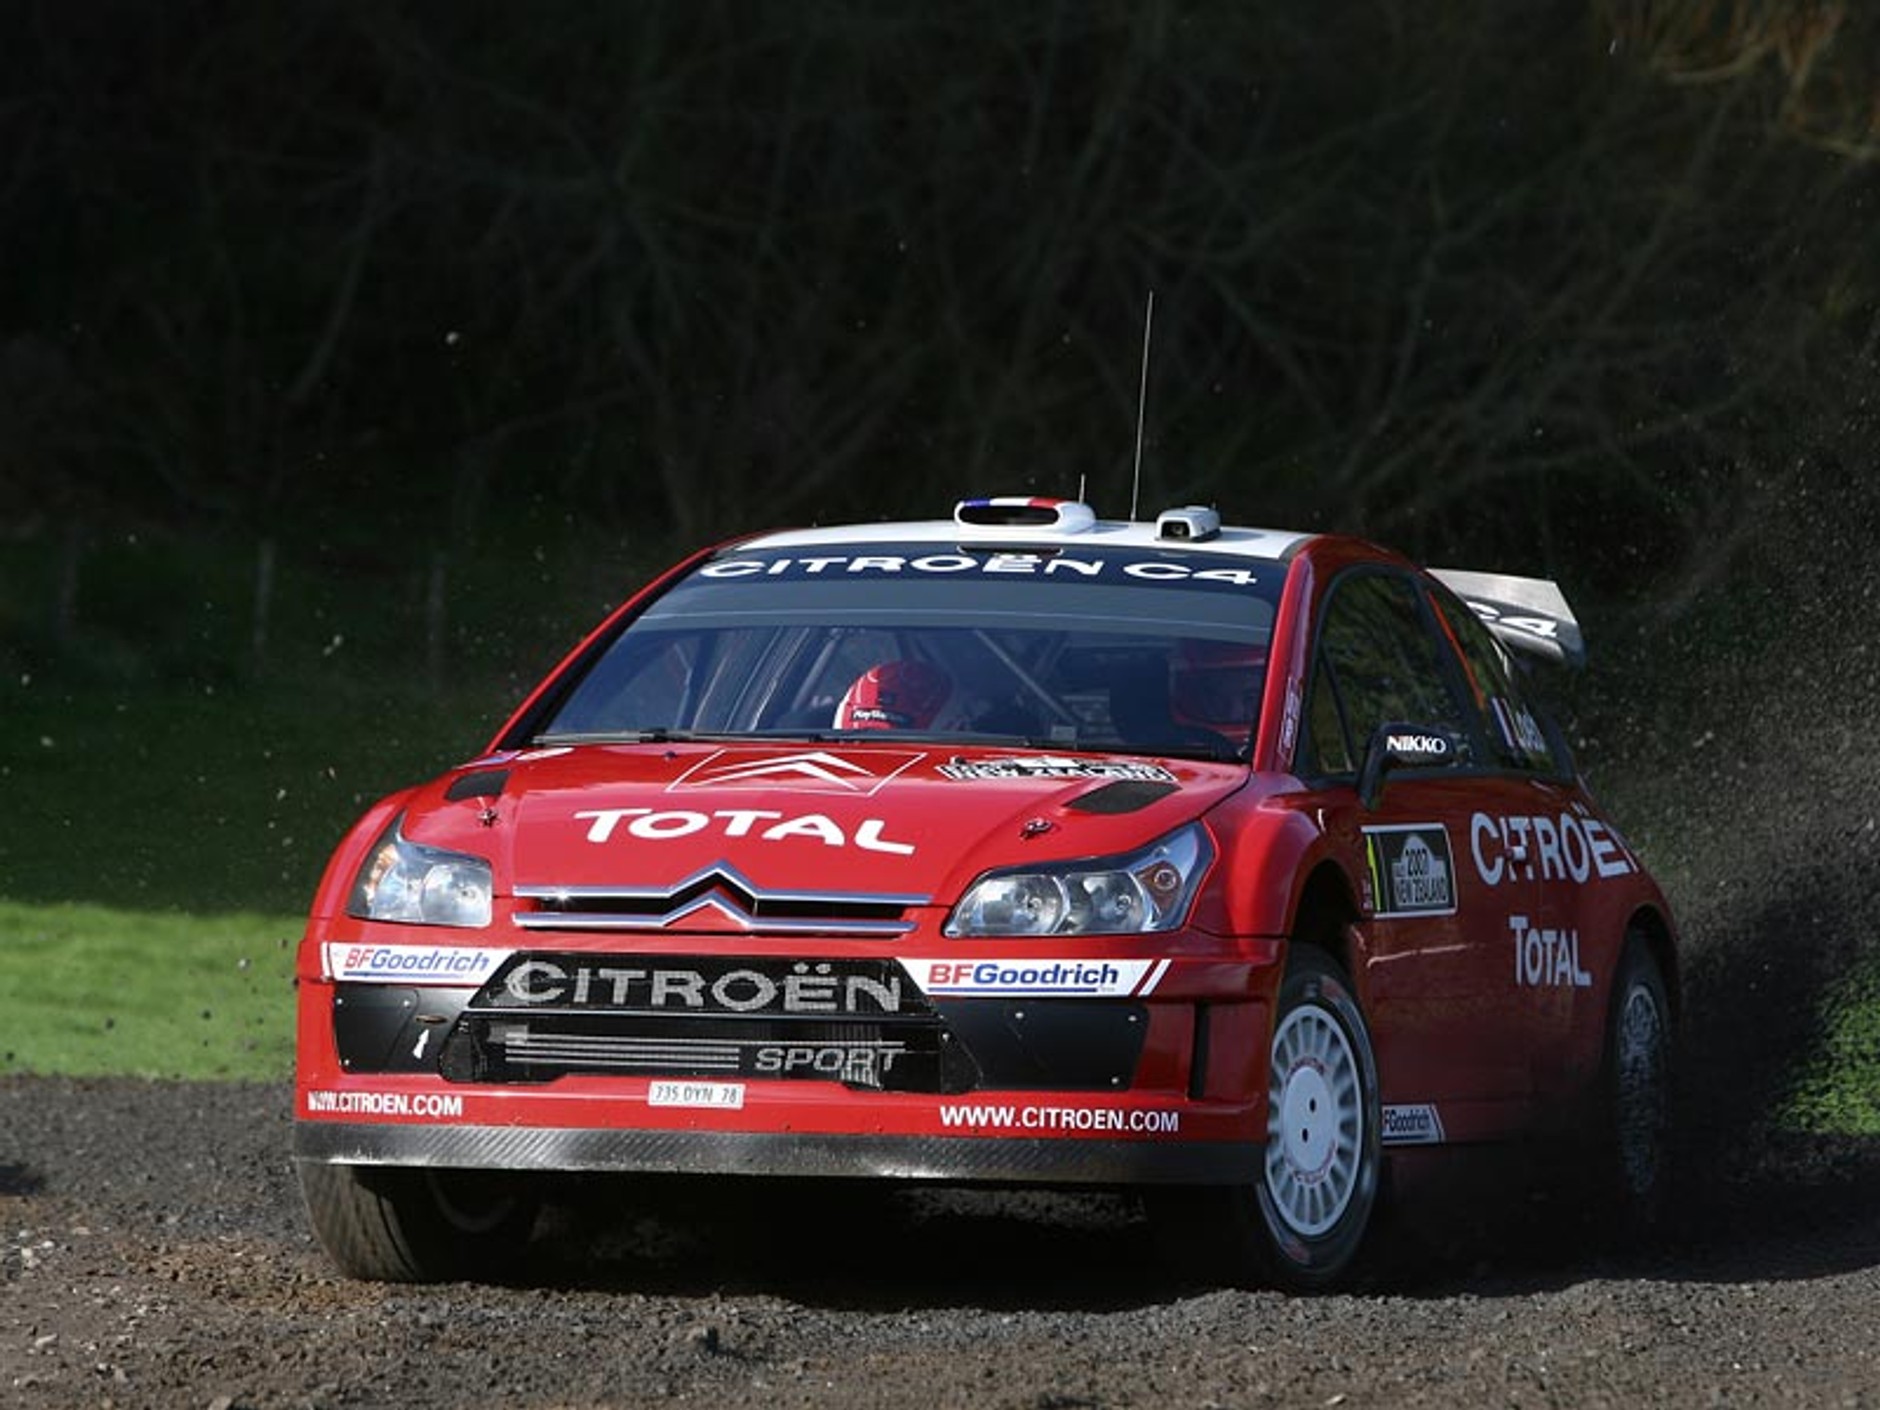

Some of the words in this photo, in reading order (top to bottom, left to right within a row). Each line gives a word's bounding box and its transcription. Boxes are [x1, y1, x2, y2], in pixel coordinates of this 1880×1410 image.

[701, 552, 1104, 577] CITROËN
[1124, 563, 1257, 585] C4
[1385, 735, 1447, 753] NIKKO
[574, 808, 916, 856] TOTAL
[344, 947, 490, 972] BFGoodrich
[1509, 915, 1592, 987] TOTAL
[504, 960, 900, 1013] CITROËN
[927, 963, 1119, 985] BFGoodrich
[754, 1047, 907, 1073] SPORT
[307, 1090, 463, 1117] WWW.CITROEN.COM
[940, 1105, 1179, 1132] WWW.CITROEN.COM
[1383, 1108, 1430, 1131] FGoodrich
